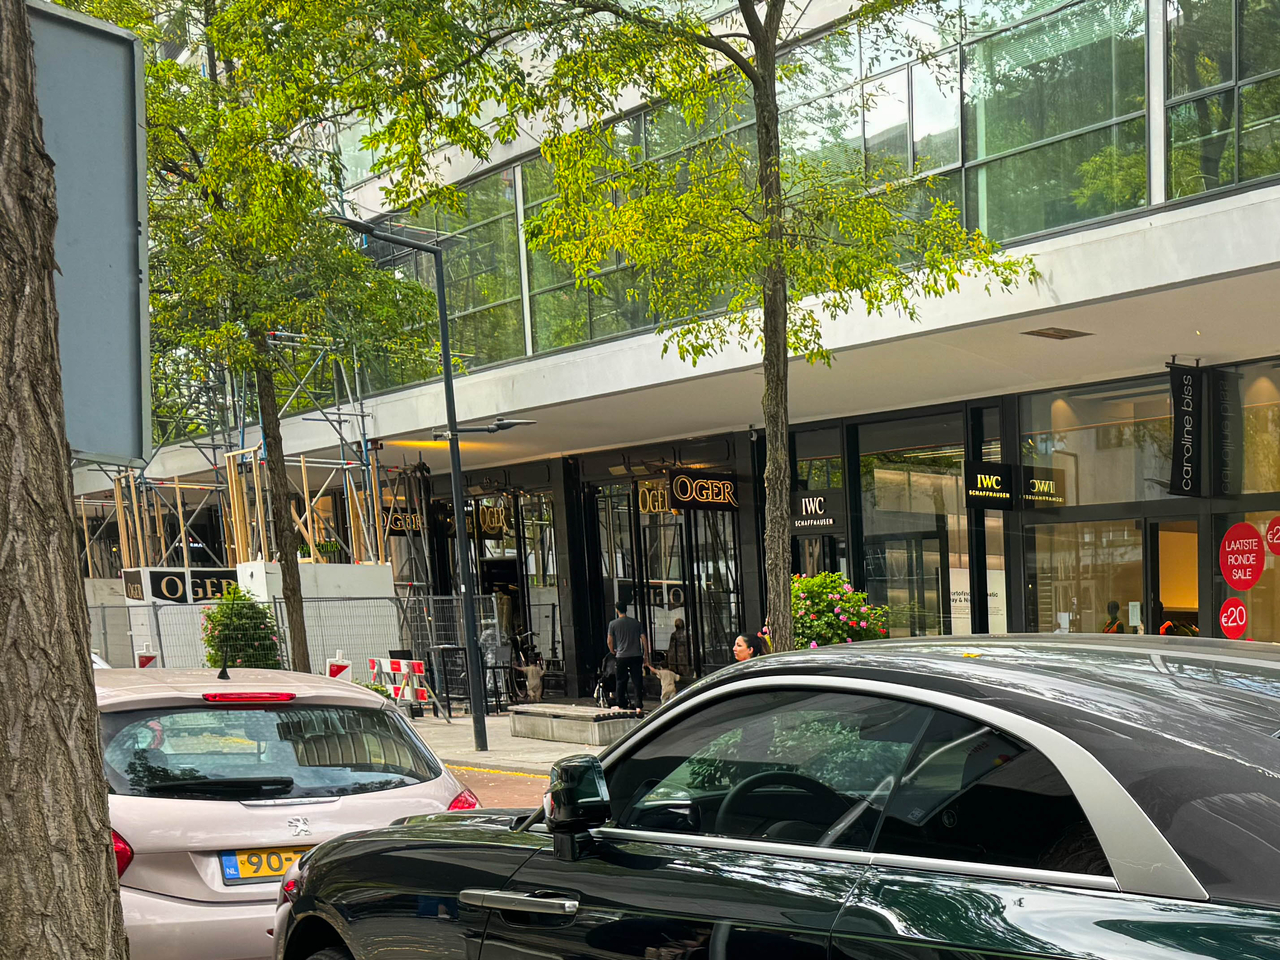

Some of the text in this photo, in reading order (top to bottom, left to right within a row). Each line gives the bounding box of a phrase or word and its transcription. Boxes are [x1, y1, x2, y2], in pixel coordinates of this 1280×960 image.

[1181, 374, 1193, 491] caroline biss
[976, 474, 1002, 490] IWC
[673, 475, 739, 508] OGER
[968, 489, 1010, 498] SCHAFFHAUSEN
[801, 497, 825, 516] IWC
[794, 518, 834, 527] SCHAFFHAUSEN
[1225, 538, 1259, 551] LAATSTE
[1227, 553, 1257, 566] RONDE
[1232, 568, 1253, 580] SALE
[1221, 606, 1247, 627] €20
